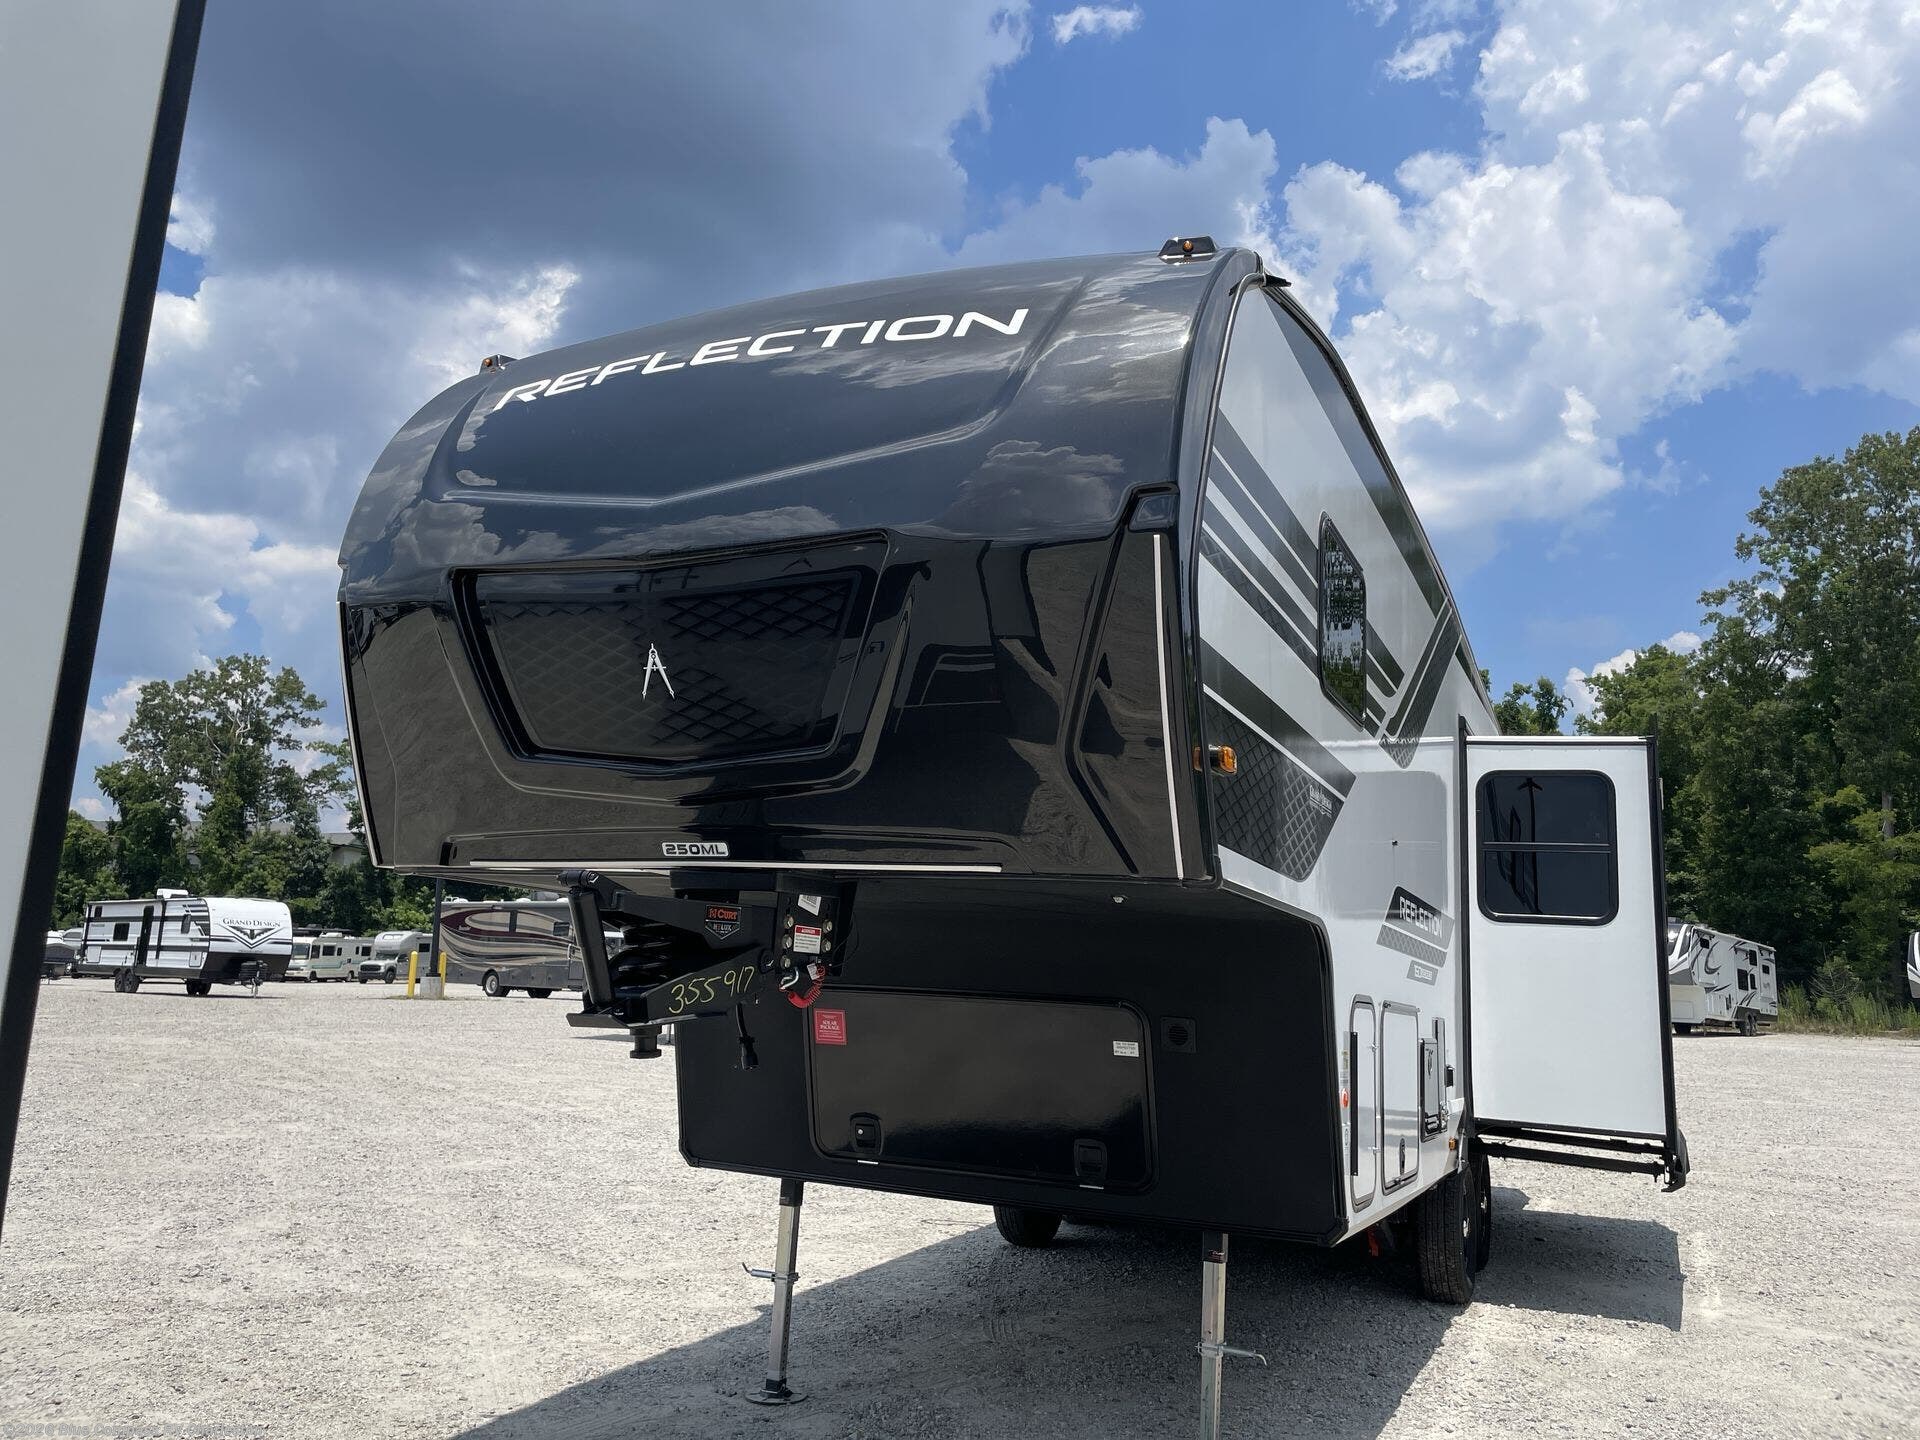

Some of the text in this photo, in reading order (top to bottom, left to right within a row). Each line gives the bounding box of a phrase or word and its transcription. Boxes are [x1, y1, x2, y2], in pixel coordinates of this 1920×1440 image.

[492, 307, 1030, 412] REFLECTION
[664, 843, 726, 855] 250ML
[1399, 896, 1443, 940] REFLECTION
